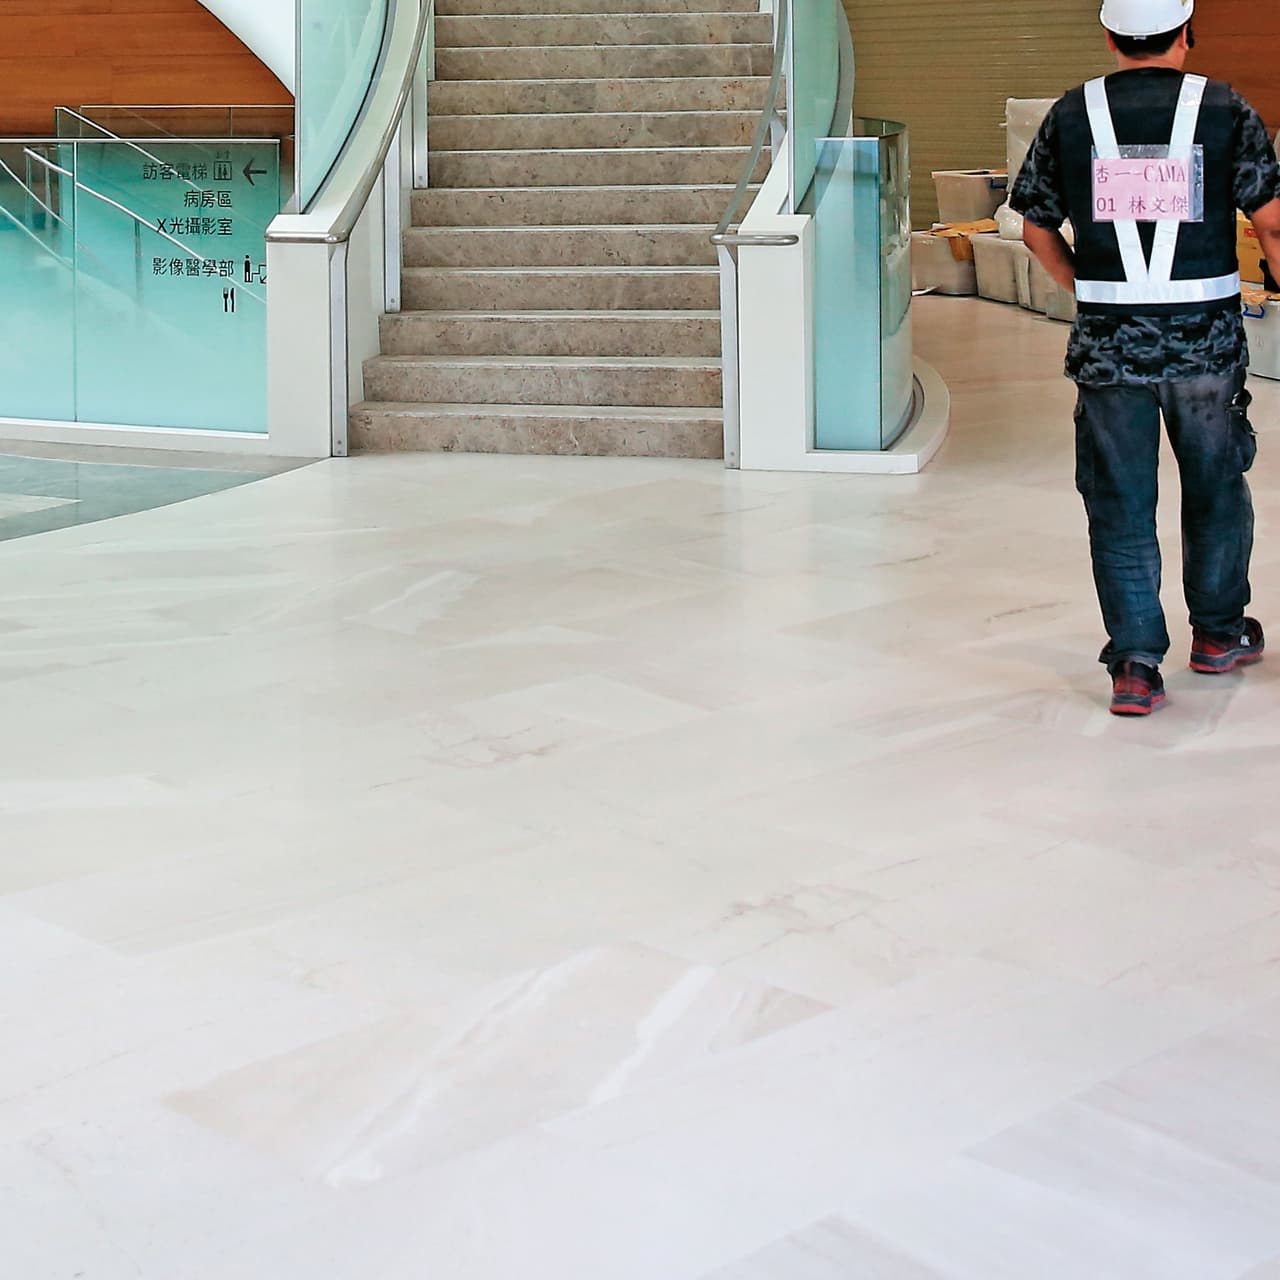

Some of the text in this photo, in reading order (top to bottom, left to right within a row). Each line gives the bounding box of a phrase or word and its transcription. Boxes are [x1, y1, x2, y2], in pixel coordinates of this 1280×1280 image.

[143, 162, 207, 181] 訪客電梯
[183, 189, 233, 208] 病房區
[1096, 197, 1116, 212] 01
[156, 216, 233, 236] X光攝影室
[152, 257, 235, 278] 影像醫學部
